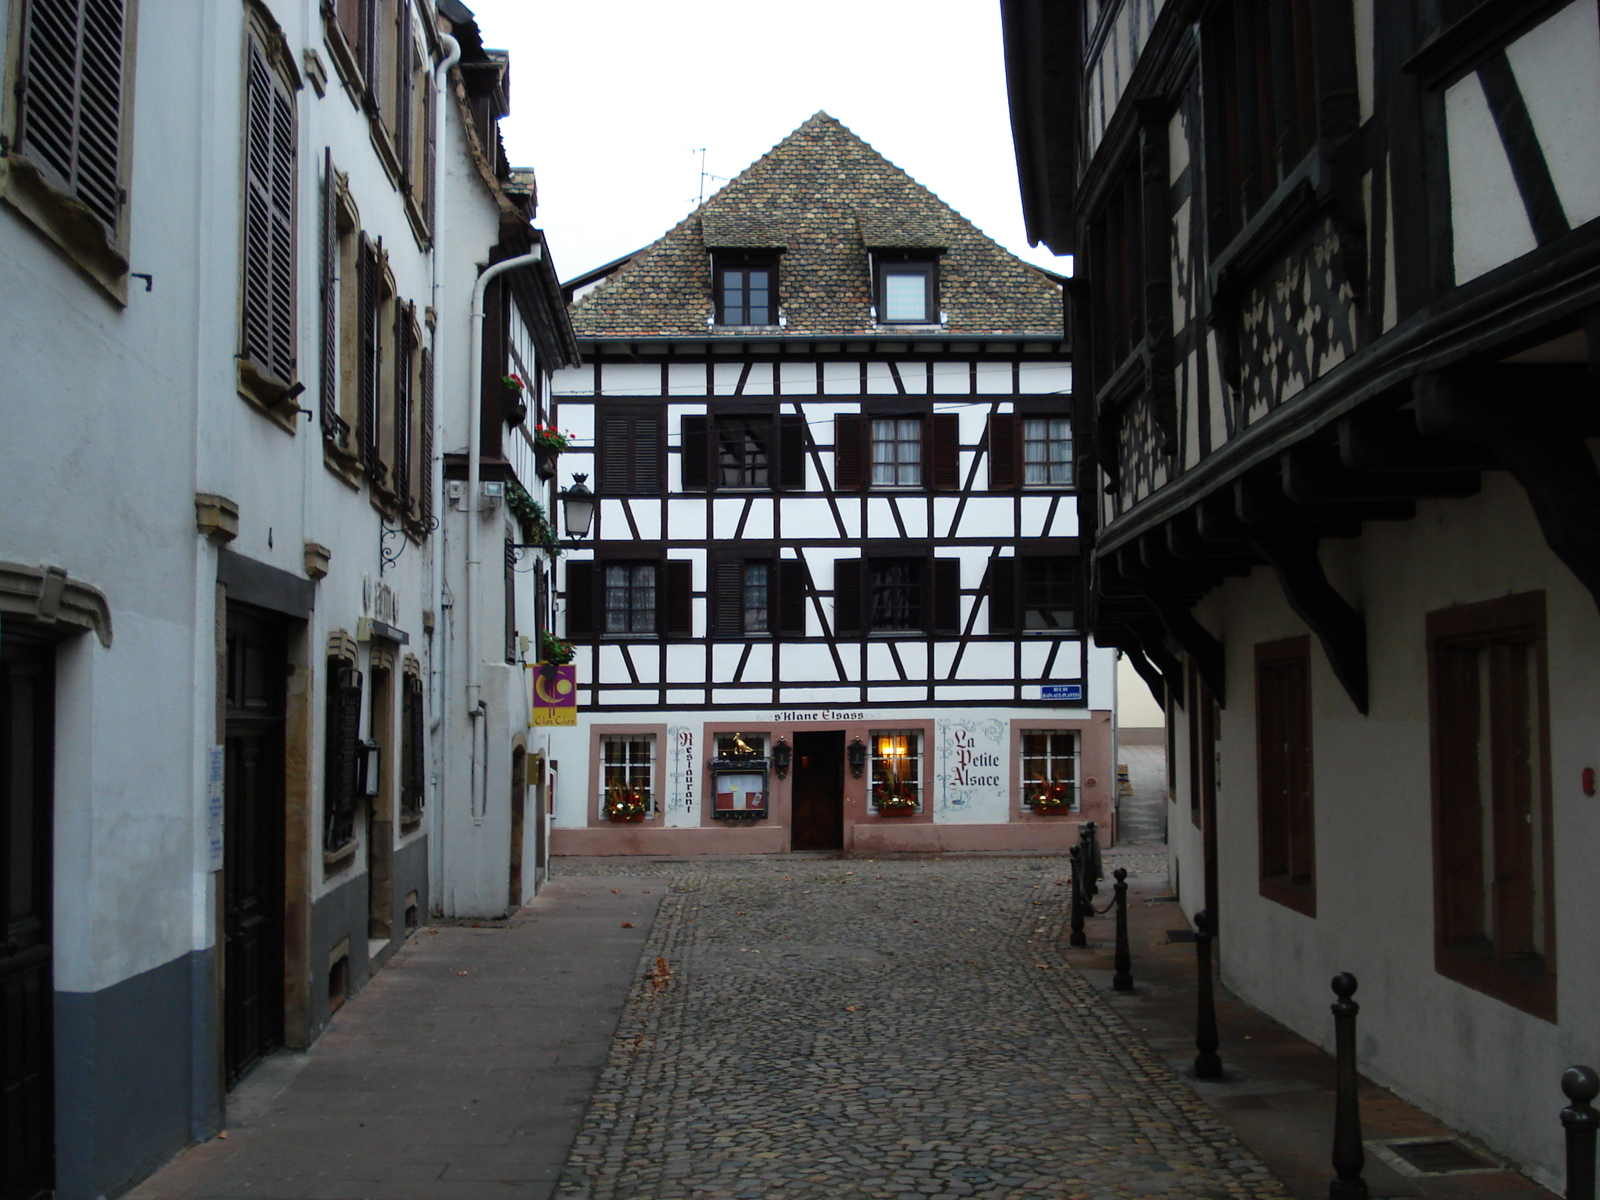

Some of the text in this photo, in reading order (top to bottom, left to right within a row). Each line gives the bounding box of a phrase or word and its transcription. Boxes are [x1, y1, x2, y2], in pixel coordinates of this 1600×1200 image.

[822, 709, 864, 720] Elsass
[954, 729, 975, 749] La
[956, 749, 1000, 772] Petite
[679, 732, 693, 813] Restaurant
[949, 766, 1000, 791] Alsace
